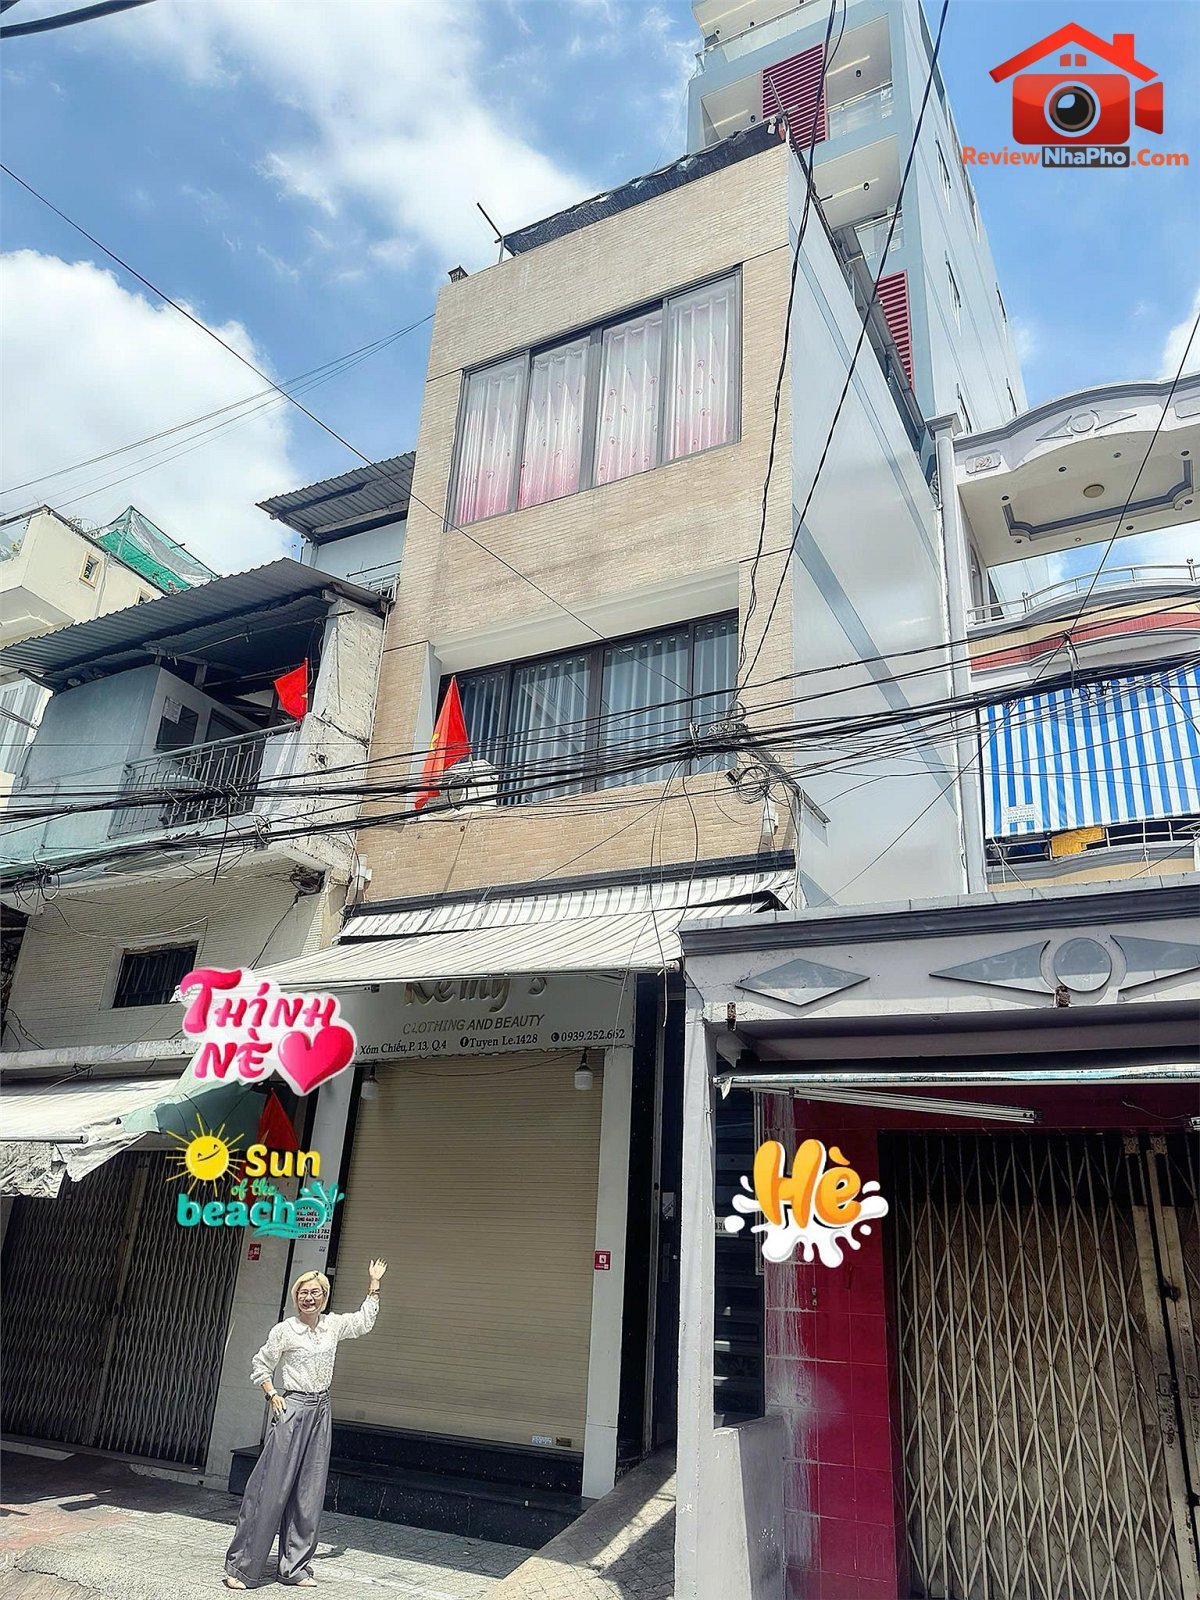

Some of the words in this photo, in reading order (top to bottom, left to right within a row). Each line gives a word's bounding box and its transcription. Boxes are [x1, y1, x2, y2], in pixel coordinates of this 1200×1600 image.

[402, 1019, 466, 1035] CLOTHING
[467, 1018, 494, 1031] AND
[495, 1014, 545, 1029] BEAUTY
[470, 1037, 499, 1050] Tuyen
